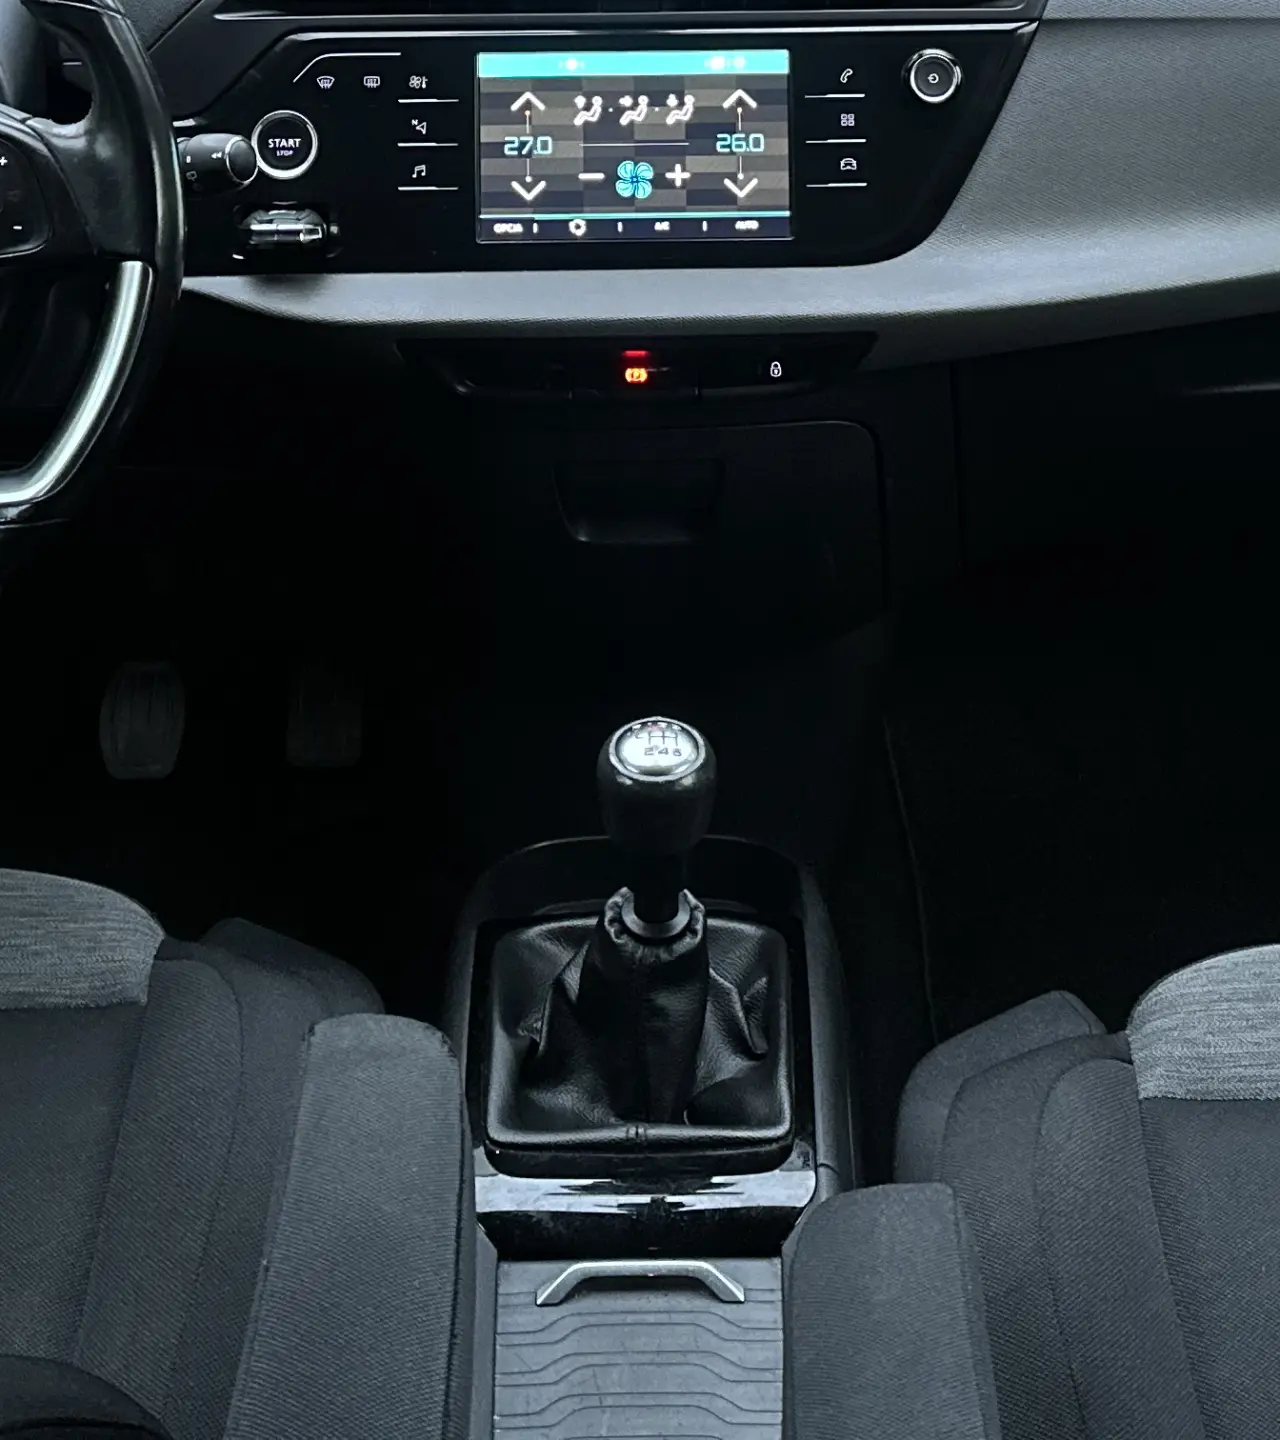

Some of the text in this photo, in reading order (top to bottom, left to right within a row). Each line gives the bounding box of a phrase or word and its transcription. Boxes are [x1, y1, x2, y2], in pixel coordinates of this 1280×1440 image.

[268, 138, 302, 148] START
[504, 136, 552, 155] 27.0
[716, 133, 765, 153] 26.0
[735, 220, 759, 230] AUTO
